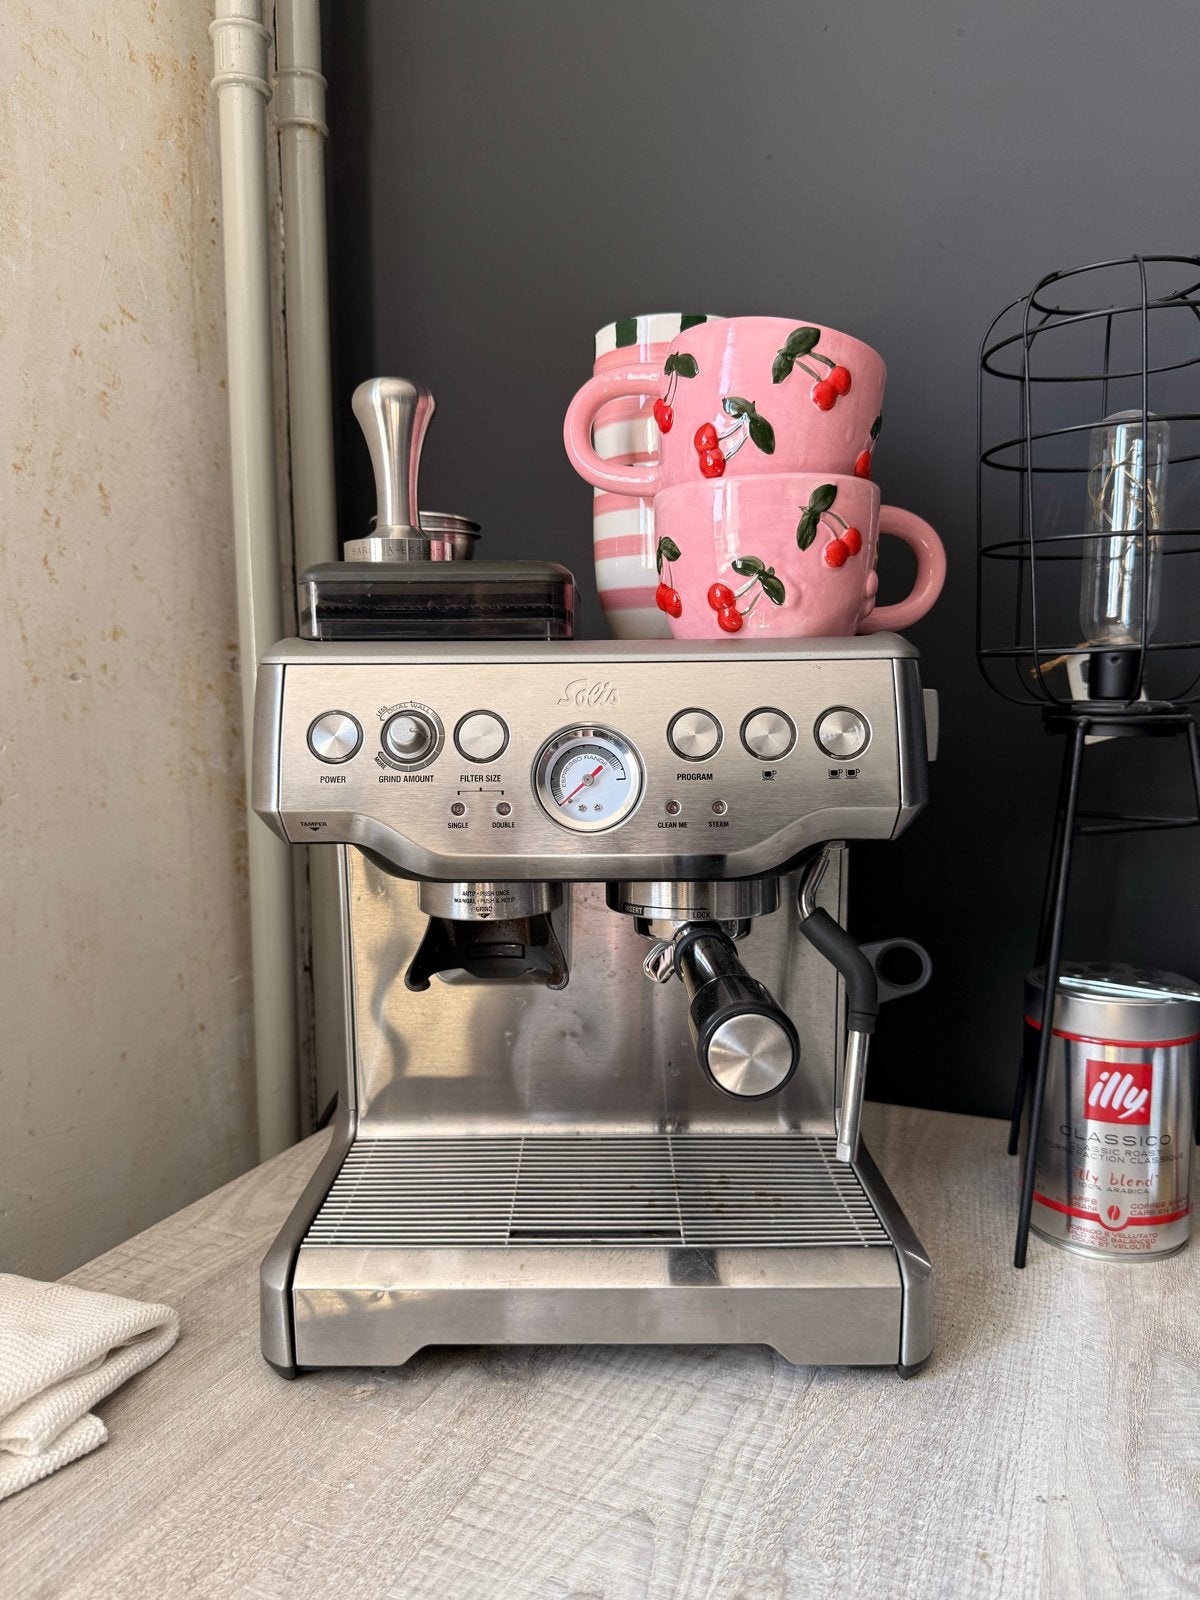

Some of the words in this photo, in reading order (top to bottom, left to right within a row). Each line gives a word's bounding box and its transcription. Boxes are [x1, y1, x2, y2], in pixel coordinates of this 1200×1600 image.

[556, 678, 621, 707] Solis
[410, 703, 431, 715] WALL
[373, 756, 387, 771] MORE
[561, 756, 583, 788] ESPRESSO
[583, 755, 608, 768] RANGE
[676, 773, 714, 781] PROGRAM
[378, 775, 402, 784] GRIND
[403, 775, 435, 784] AMOUNT
[459, 774, 484, 783] FILTER
[485, 774, 502, 783] SIZE
[491, 821, 516, 829] DOUBLE
[1088, 1071, 1149, 1120] illy
[1059, 1124, 1171, 1147] CLASSICO
[1124, 1149, 1162, 1157] ROAST
[1072, 1167, 1100, 1185] illy
[1106, 1187, 1150, 1195] ARABICA
[1071, 1234, 1096, 1246] DOUX
[1112, 1231, 1159, 1239] VELLUTATO
